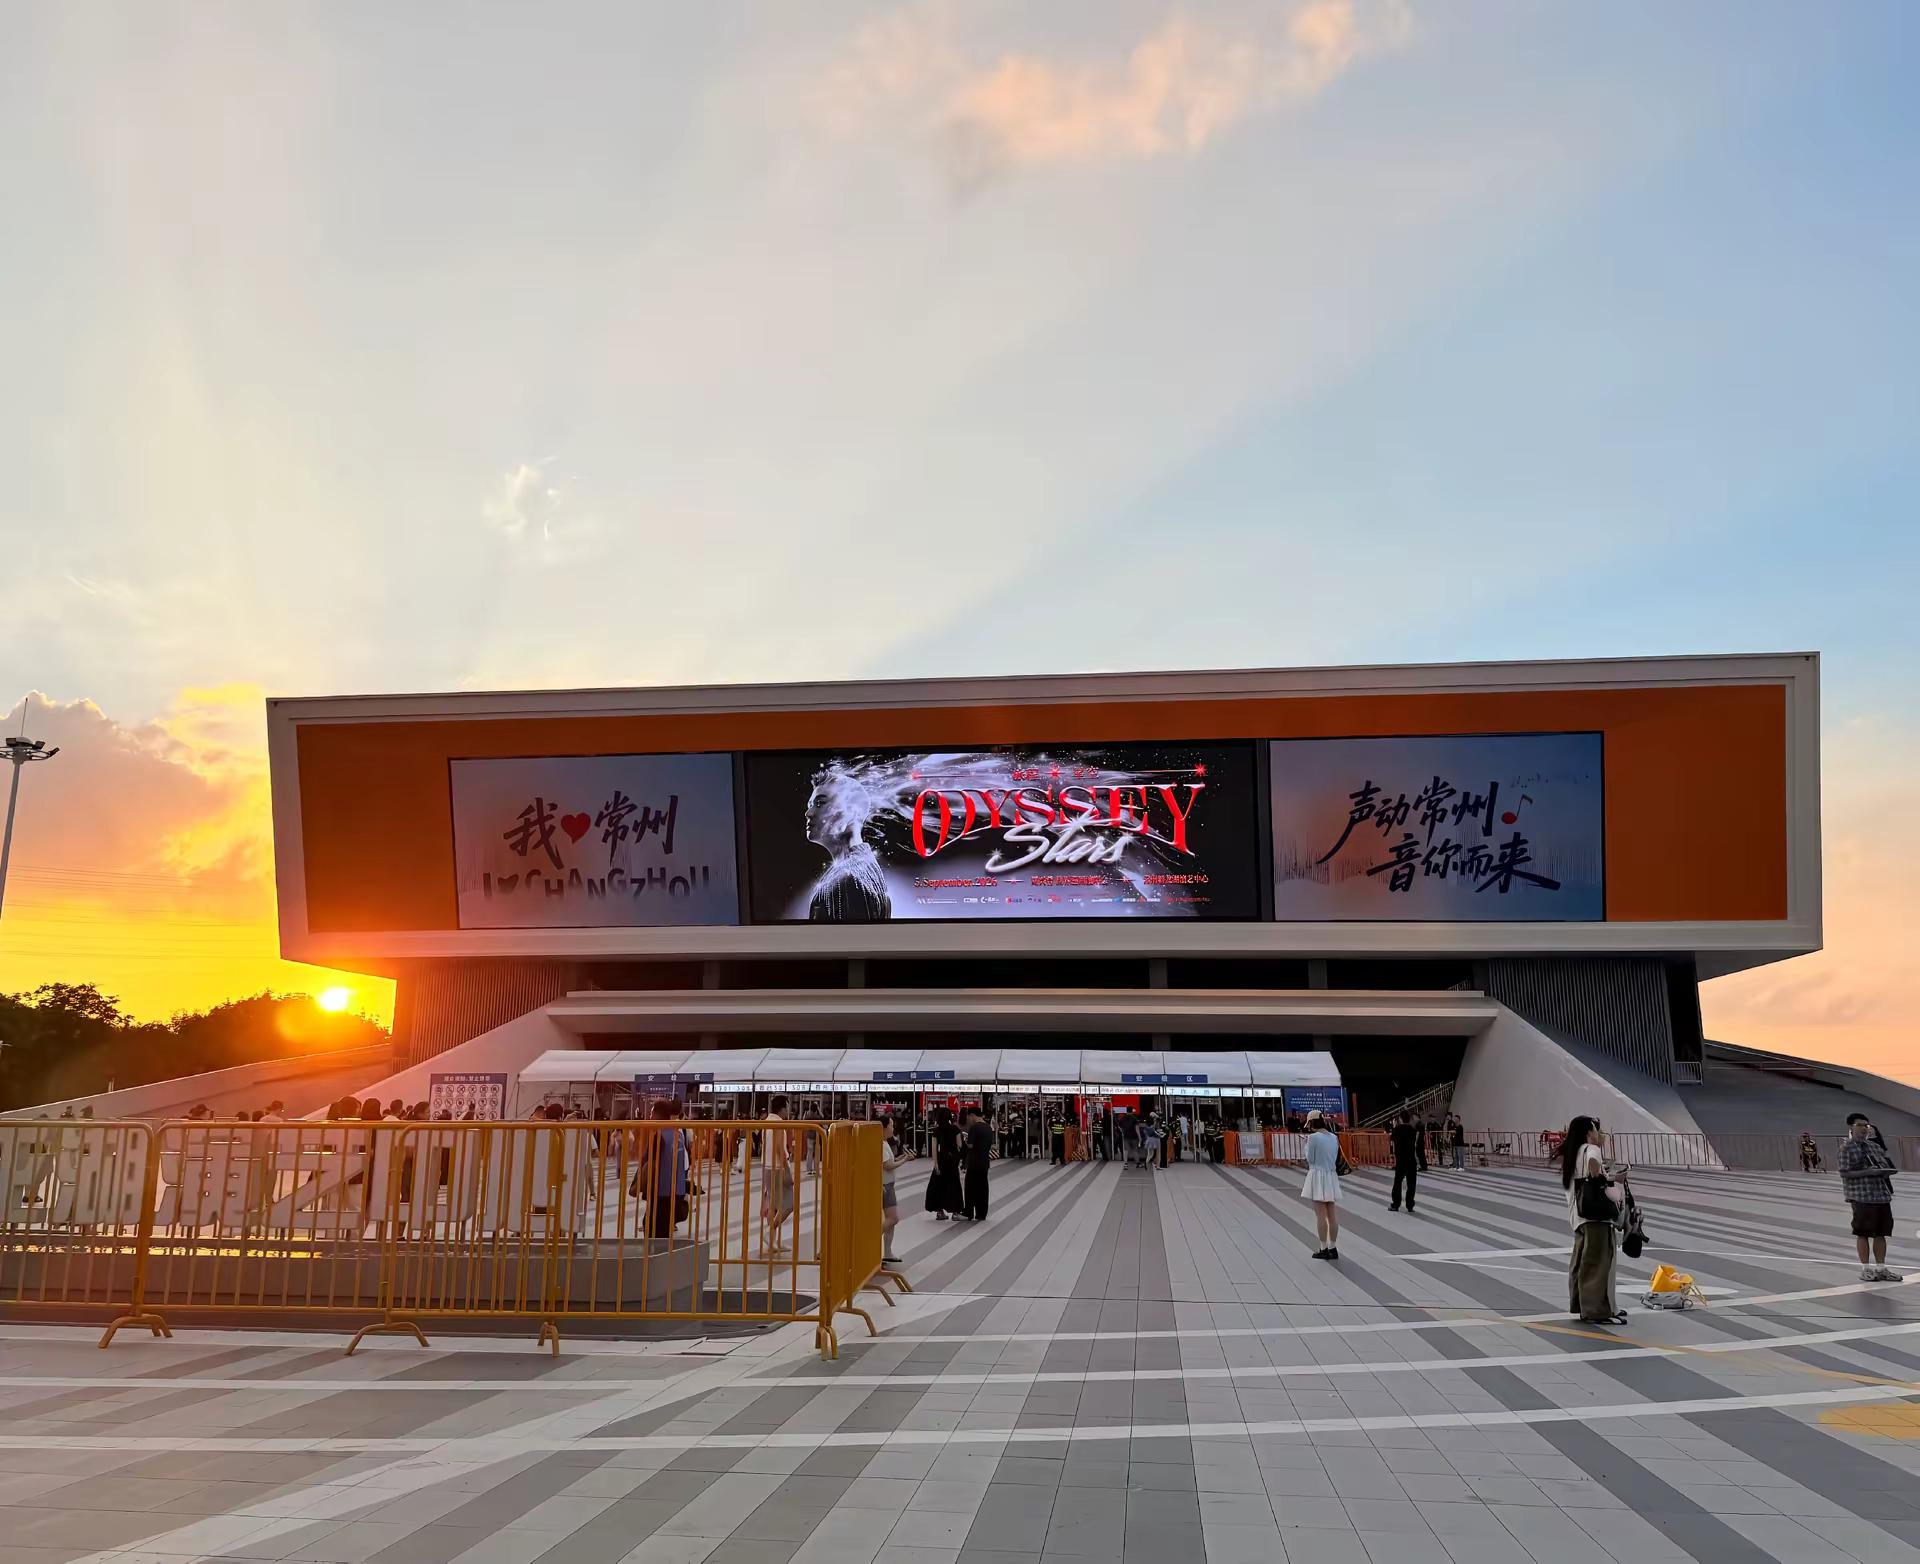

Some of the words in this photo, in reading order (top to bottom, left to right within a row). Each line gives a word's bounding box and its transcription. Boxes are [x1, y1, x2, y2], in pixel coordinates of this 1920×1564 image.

[503, 797, 565, 870] 我
[594, 791, 679, 867] 常州
[913, 783, 1206, 858] ODYSSEY
[985, 815, 1136, 873] Stars
[1316, 776, 1500, 865] 声动常州
[1366, 832, 1562, 894] 音你而来
